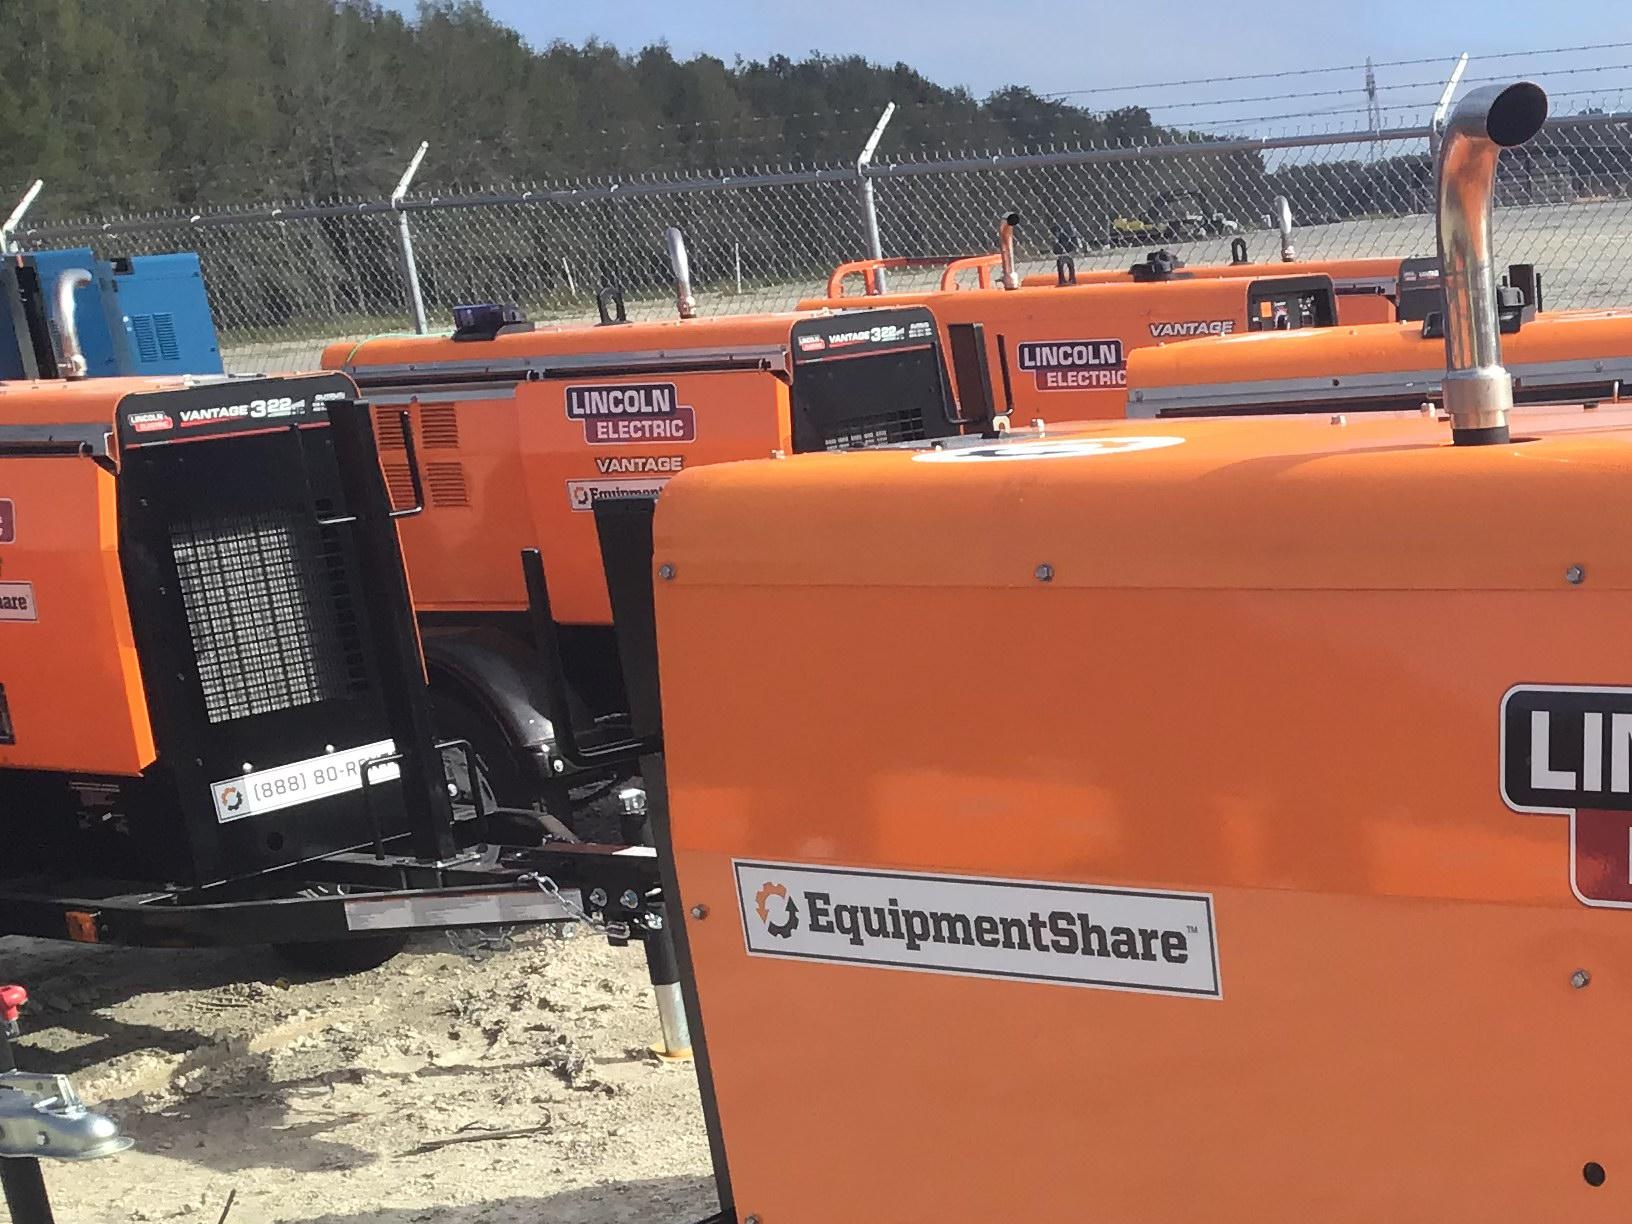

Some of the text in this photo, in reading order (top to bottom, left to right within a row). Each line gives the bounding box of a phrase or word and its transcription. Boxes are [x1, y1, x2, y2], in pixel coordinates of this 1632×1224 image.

[1150, 320, 1233, 337] VANTAGE
[1023, 344, 1116, 367] LINCOLN
[1047, 369, 1127, 387] ELECTRIC
[180, 404, 249, 421] VANTAGE
[250, 397, 292, 418] 322
[571, 388, 670, 415] LINCOLN
[597, 419, 684, 439] ELECTRIC
[596, 457, 683, 473] VANTAGE
[254, 773, 308, 801] (888)
[803, 891, 1189, 963] EquipmentShare
